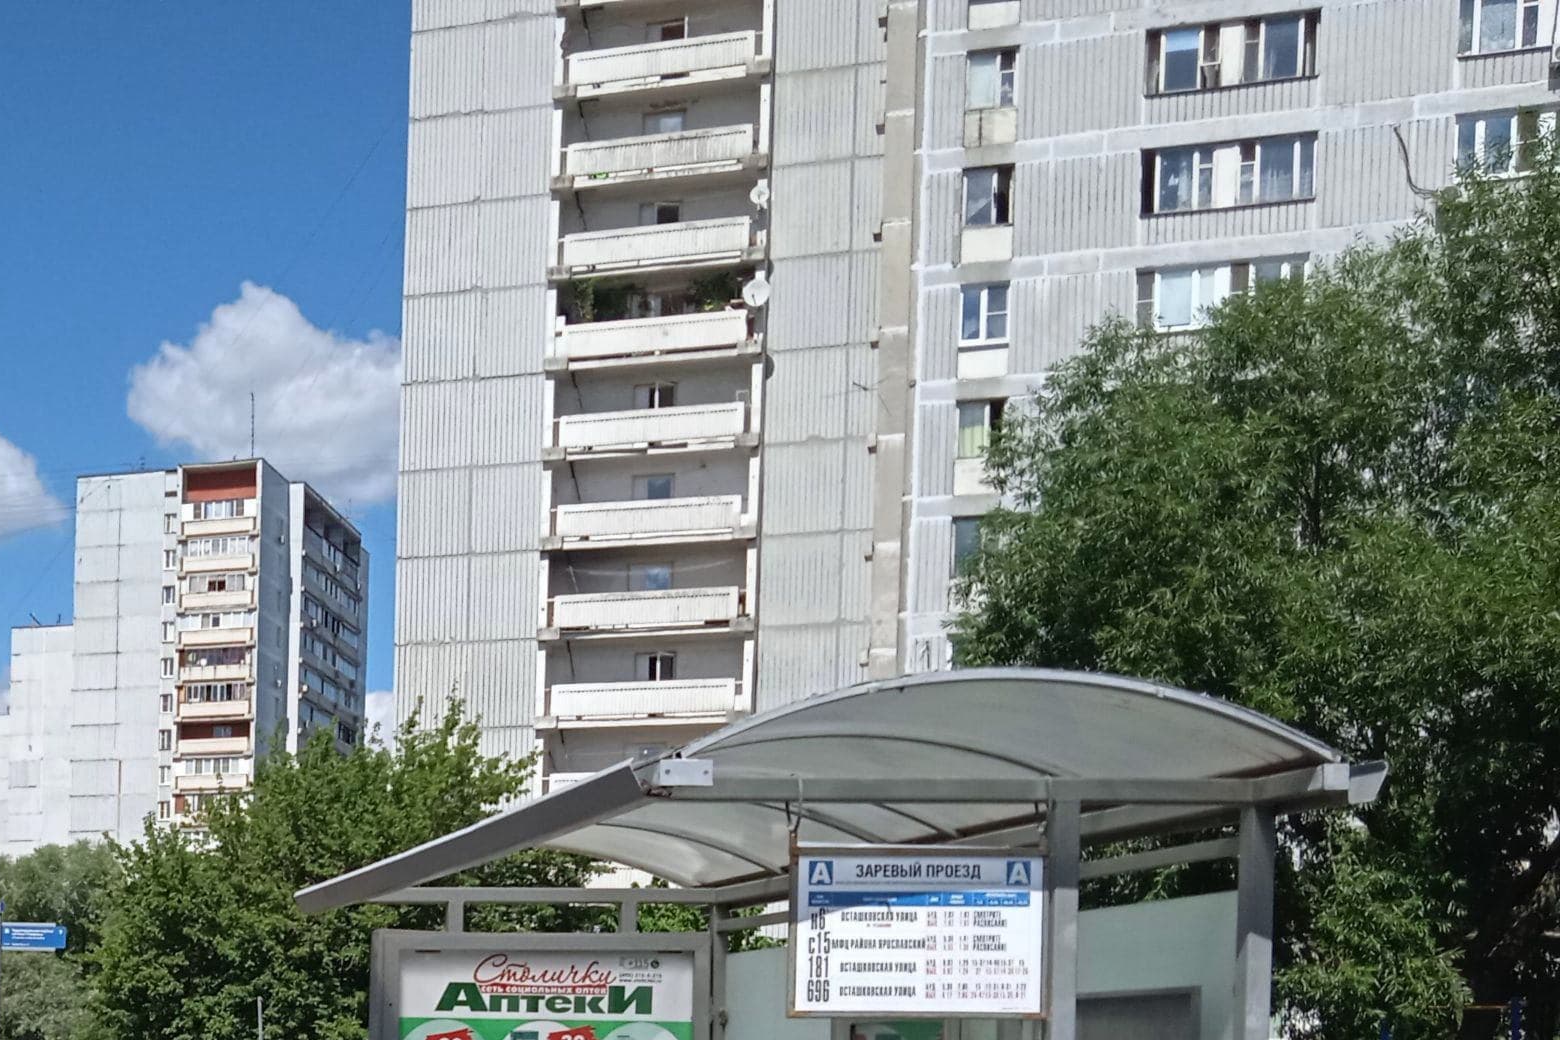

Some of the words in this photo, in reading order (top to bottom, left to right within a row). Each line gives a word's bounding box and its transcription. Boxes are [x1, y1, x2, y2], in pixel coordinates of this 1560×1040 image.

[856, 861, 922, 878] ЗАРЕВЫЙ
[926, 864, 981, 880] ПРОЕЗД
[841, 911, 894, 922] ОСТАШКОВСКАЯ
[896, 911, 918, 922] УЛИЦА
[808, 931, 831, 954] с15
[878, 937, 926, 950] ЯРОСЛАВСКИЙ
[474, 953, 617, 984] Столички
[808, 955, 829, 978] 181
[840, 962, 893, 972] ОСТАШКОВСКАЯ
[895, 962, 917, 973] УЛИЦА
[481, 986, 503, 994] сеть
[505, 986, 572, 995] социальных
[575, 987, 607, 995] аптек
[807, 979, 830, 1002] 696
[839, 986, 892, 996] ОСТАШКОВСКАЯ
[894, 986, 916, 998] УЛИЦА
